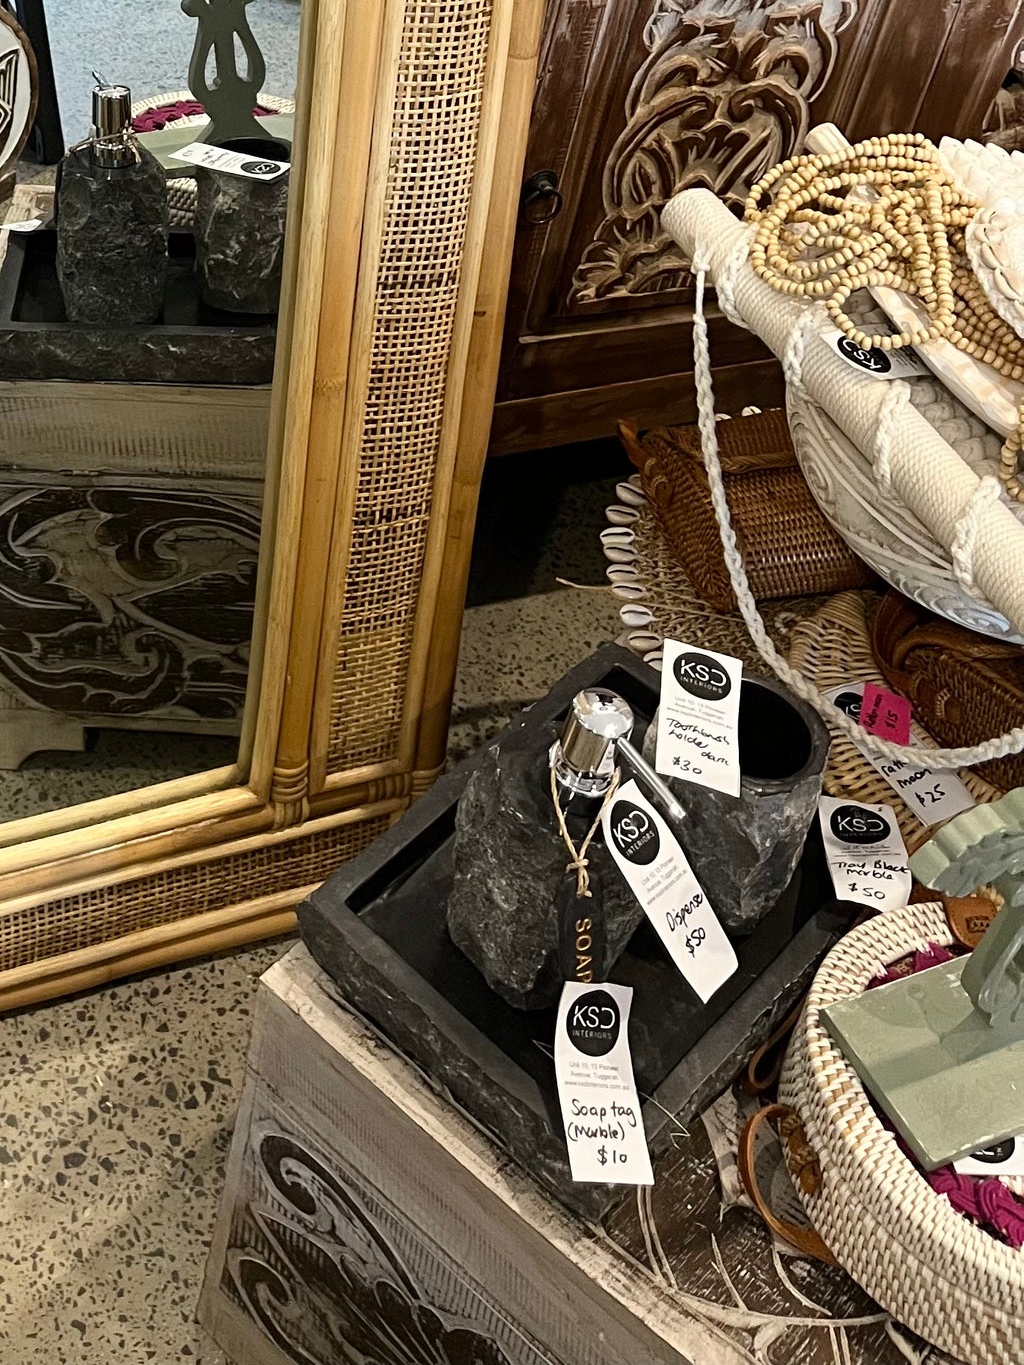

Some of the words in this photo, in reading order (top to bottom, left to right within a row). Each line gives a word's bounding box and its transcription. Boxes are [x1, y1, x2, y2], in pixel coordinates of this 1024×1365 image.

[680, 659, 728, 687] KSD
[672, 756, 703, 775] $30
[914, 783, 946, 808] $25
[613, 810, 649, 849] KSD
[837, 815, 884, 832] KSD
[848, 882, 886, 899] $50
[575, 918, 592, 983] SOAP
[685, 927, 706, 959] $50
[573, 1005, 616, 1029] KSD
[571, 1029, 612, 1040] INTERIORS
[571, 1098, 607, 1123] Soap
[610, 1100, 637, 1128] tag
[597, 1145, 628, 1166] $10
